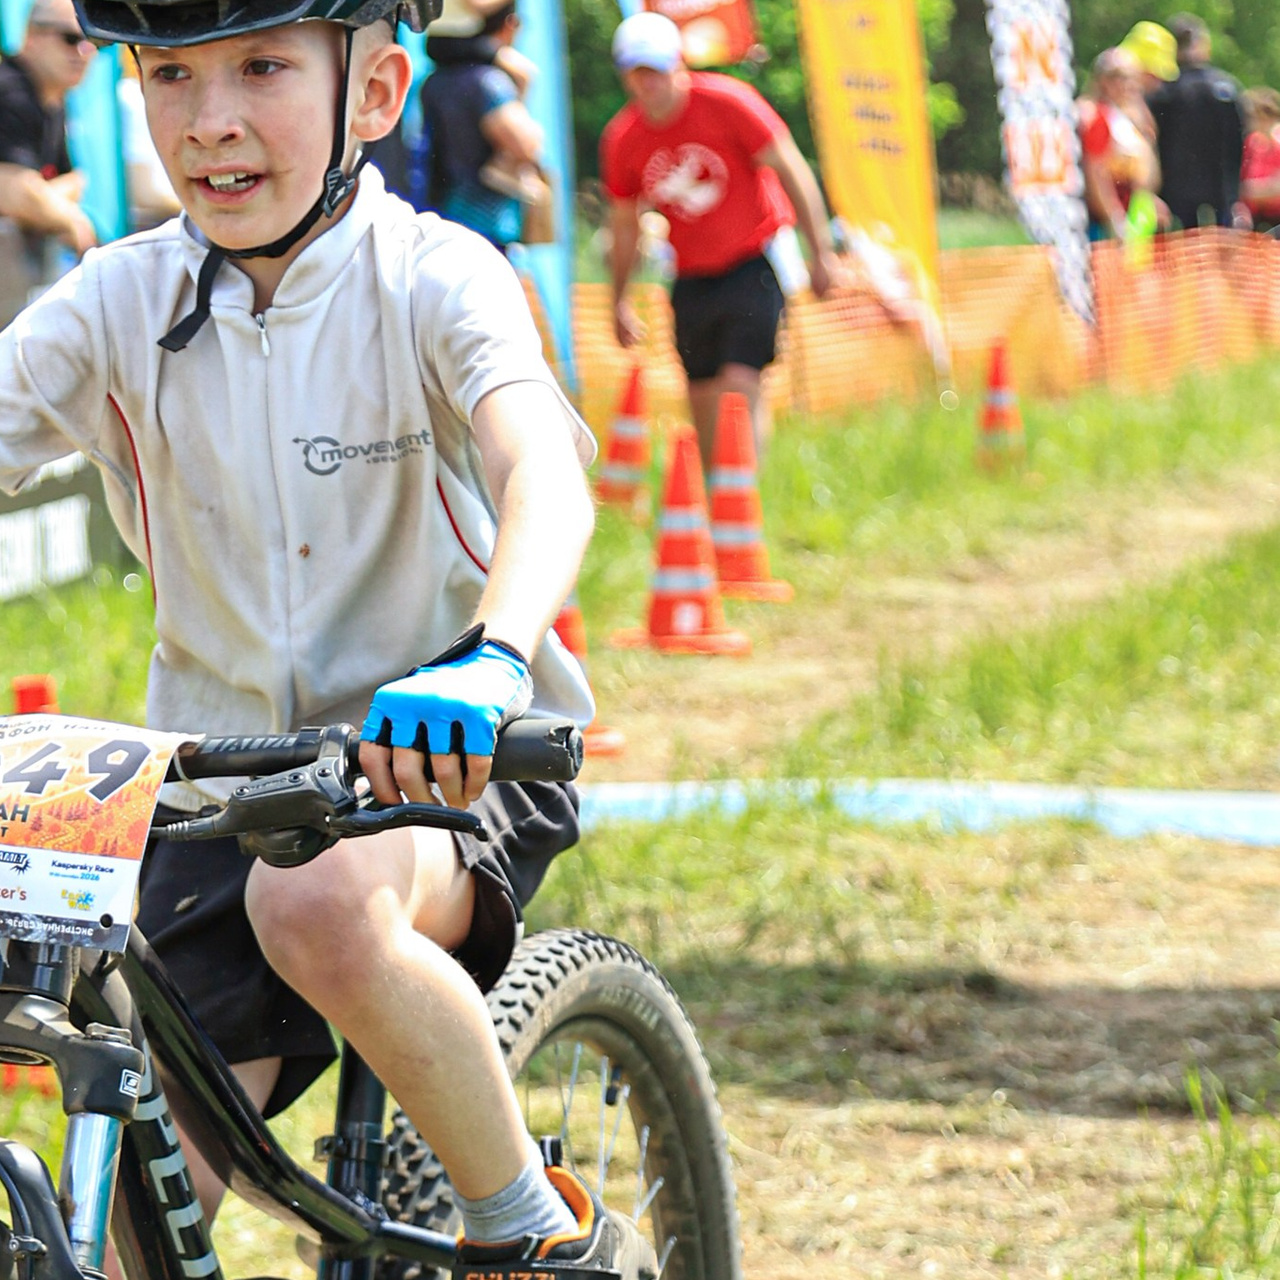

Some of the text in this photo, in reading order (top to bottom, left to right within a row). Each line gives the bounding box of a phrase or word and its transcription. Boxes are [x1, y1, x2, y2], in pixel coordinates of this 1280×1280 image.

[51, 860, 114, 873] Kaspersky Race
[80, 872, 100, 881] 2026
[36, 922, 94, 936] ЭКСТРЕННАЯ
